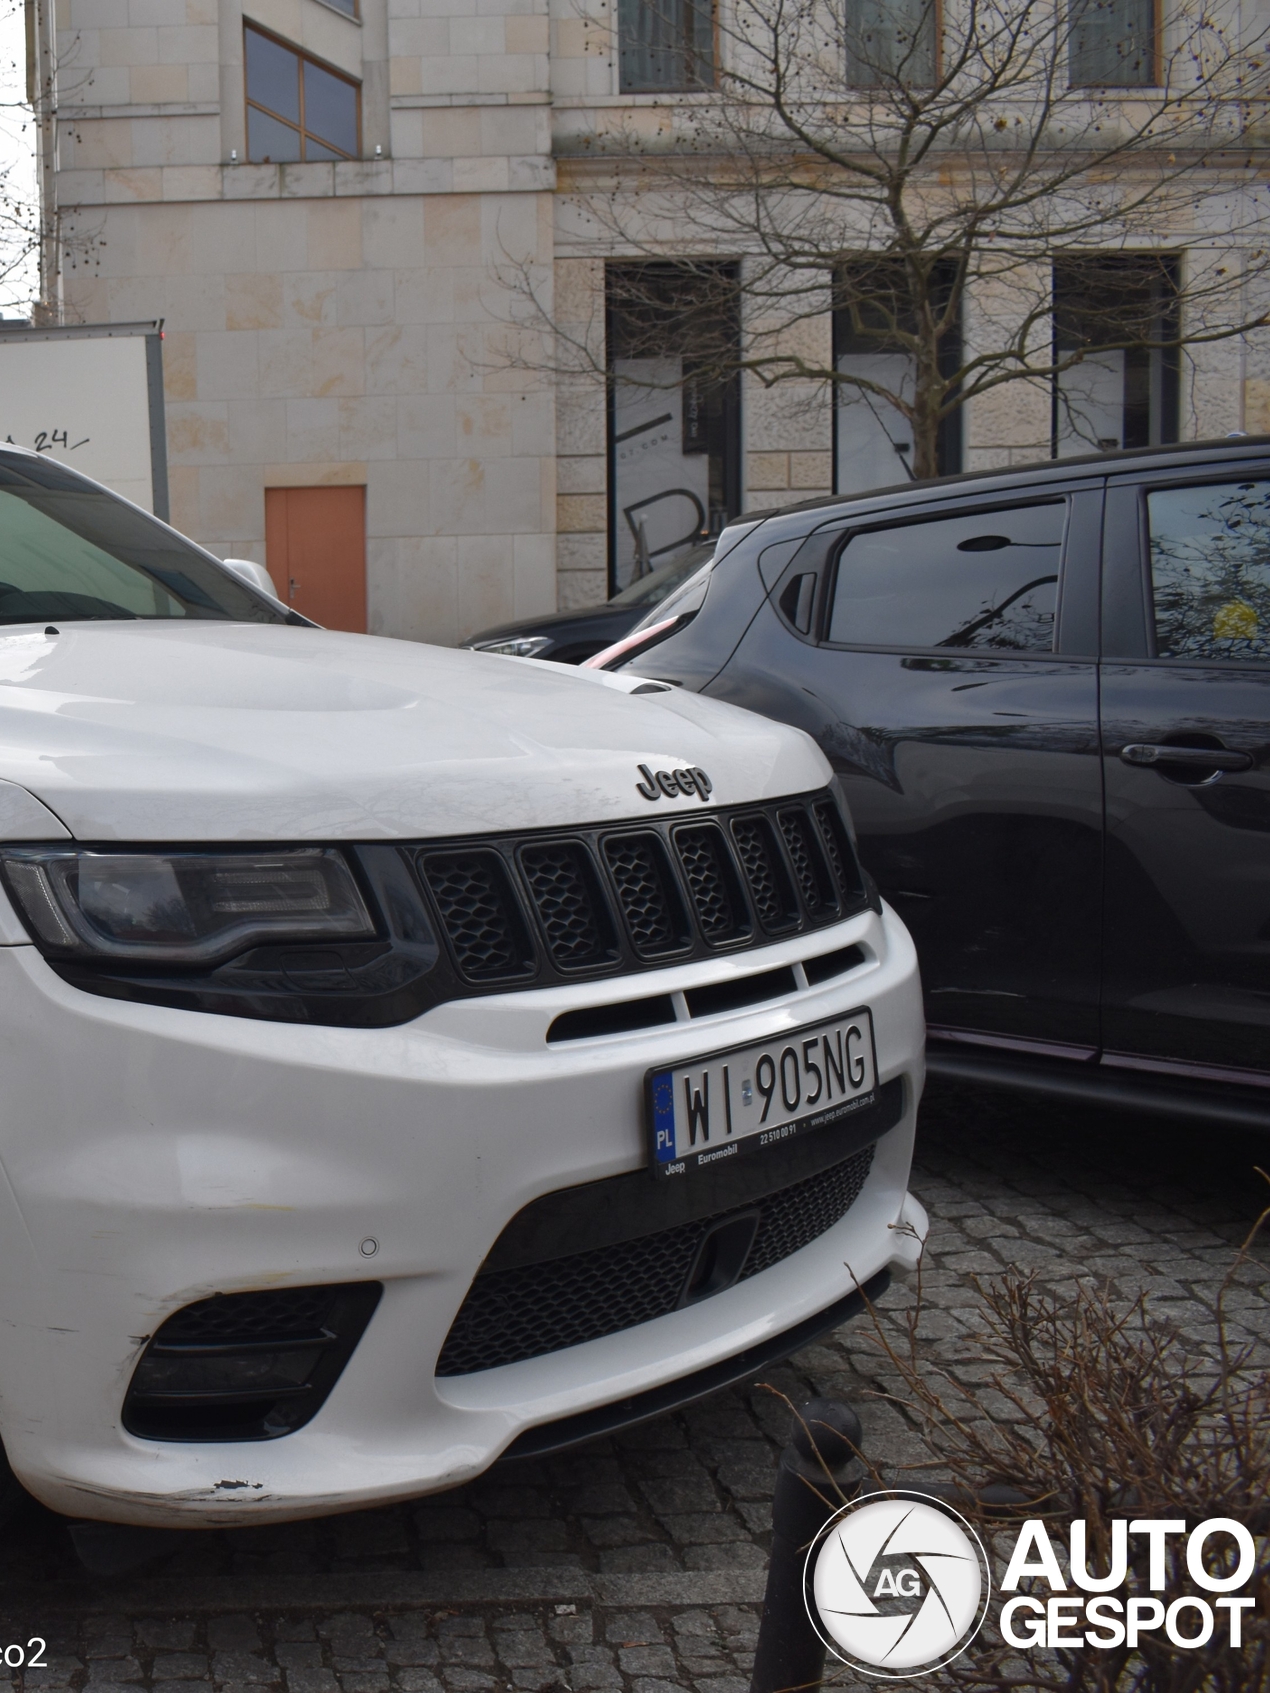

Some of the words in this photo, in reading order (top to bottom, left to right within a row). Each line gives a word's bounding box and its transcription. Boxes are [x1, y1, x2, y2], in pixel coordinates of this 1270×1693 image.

[636, 763, 713, 802] Jeep
[683, 1063, 732, 1146] WI
[755, 1024, 866, 1124] 905NG
[657, 1128, 673, 1150] PL
[665, 1162, 686, 1175] Jeep
[697, 1143, 738, 1165] Euromobil
[810, 1092, 875, 1126] www.jeep.euromobil.com.pl
